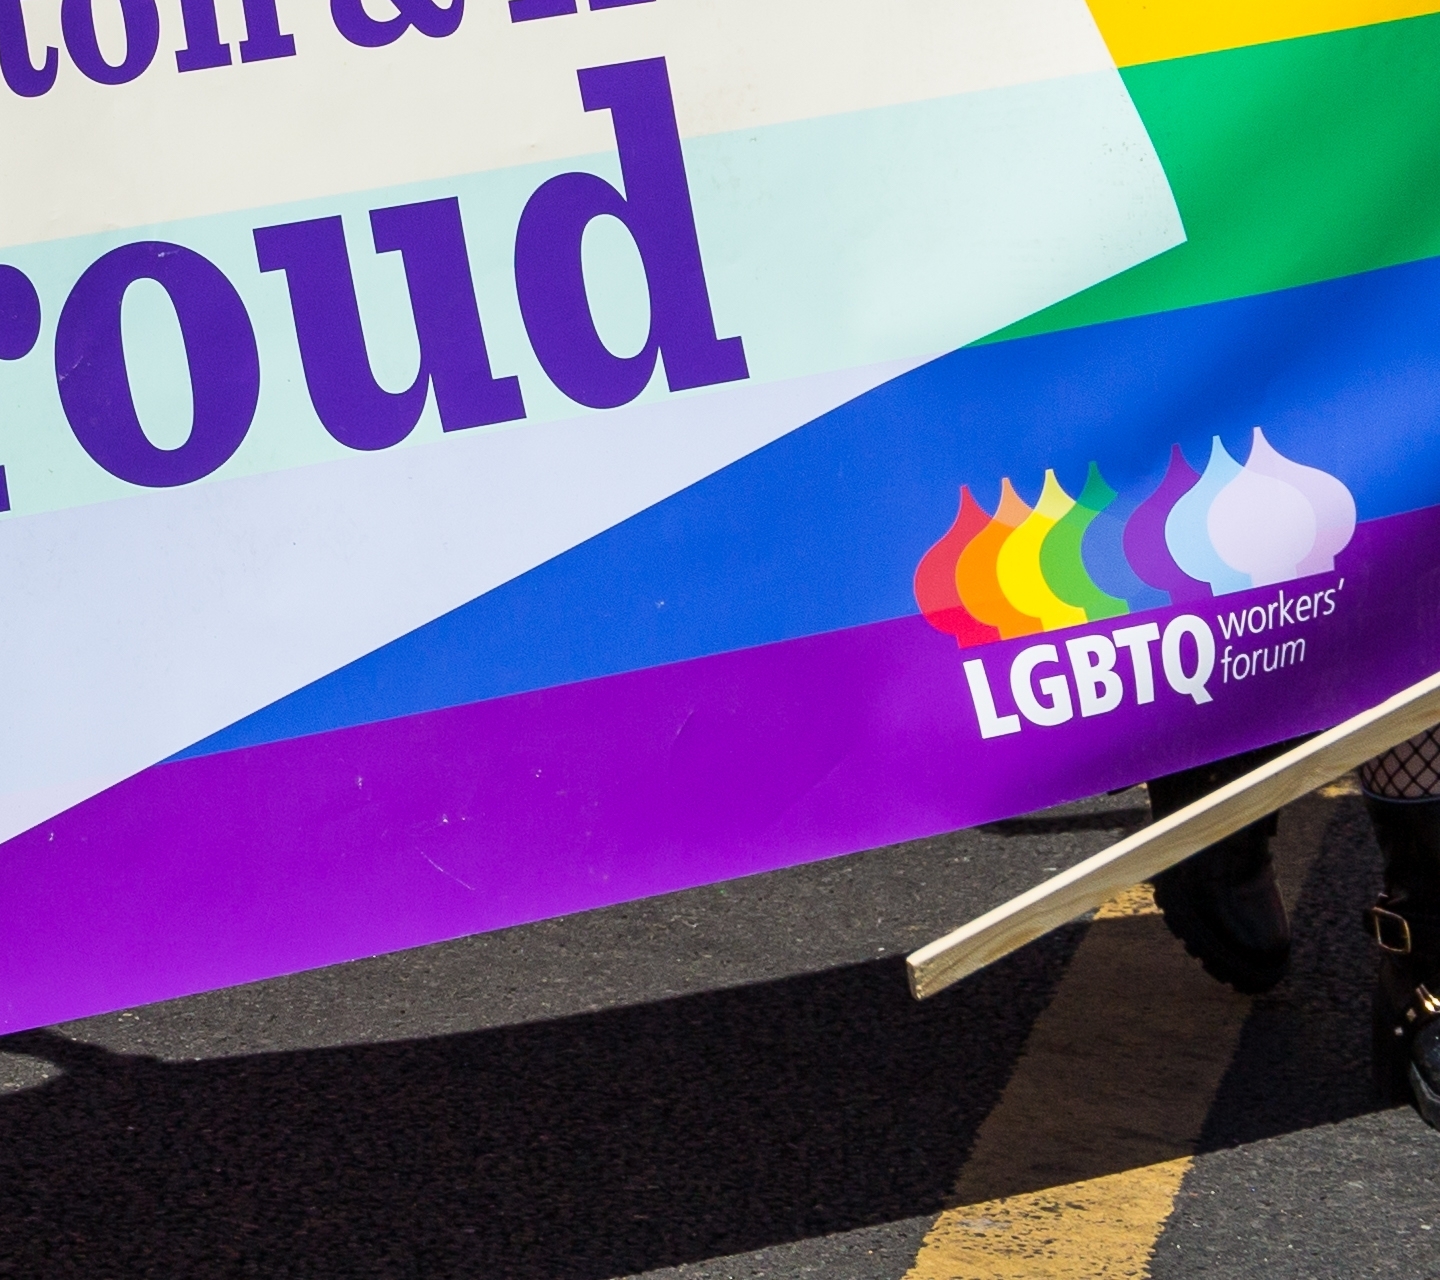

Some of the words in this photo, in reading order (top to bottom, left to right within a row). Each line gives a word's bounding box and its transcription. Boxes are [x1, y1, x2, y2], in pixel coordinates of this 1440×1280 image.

[963, 614, 1215, 740] LGBTQ
[1217, 578, 1345, 639] workers'
[1221, 636, 1306, 683] forum
